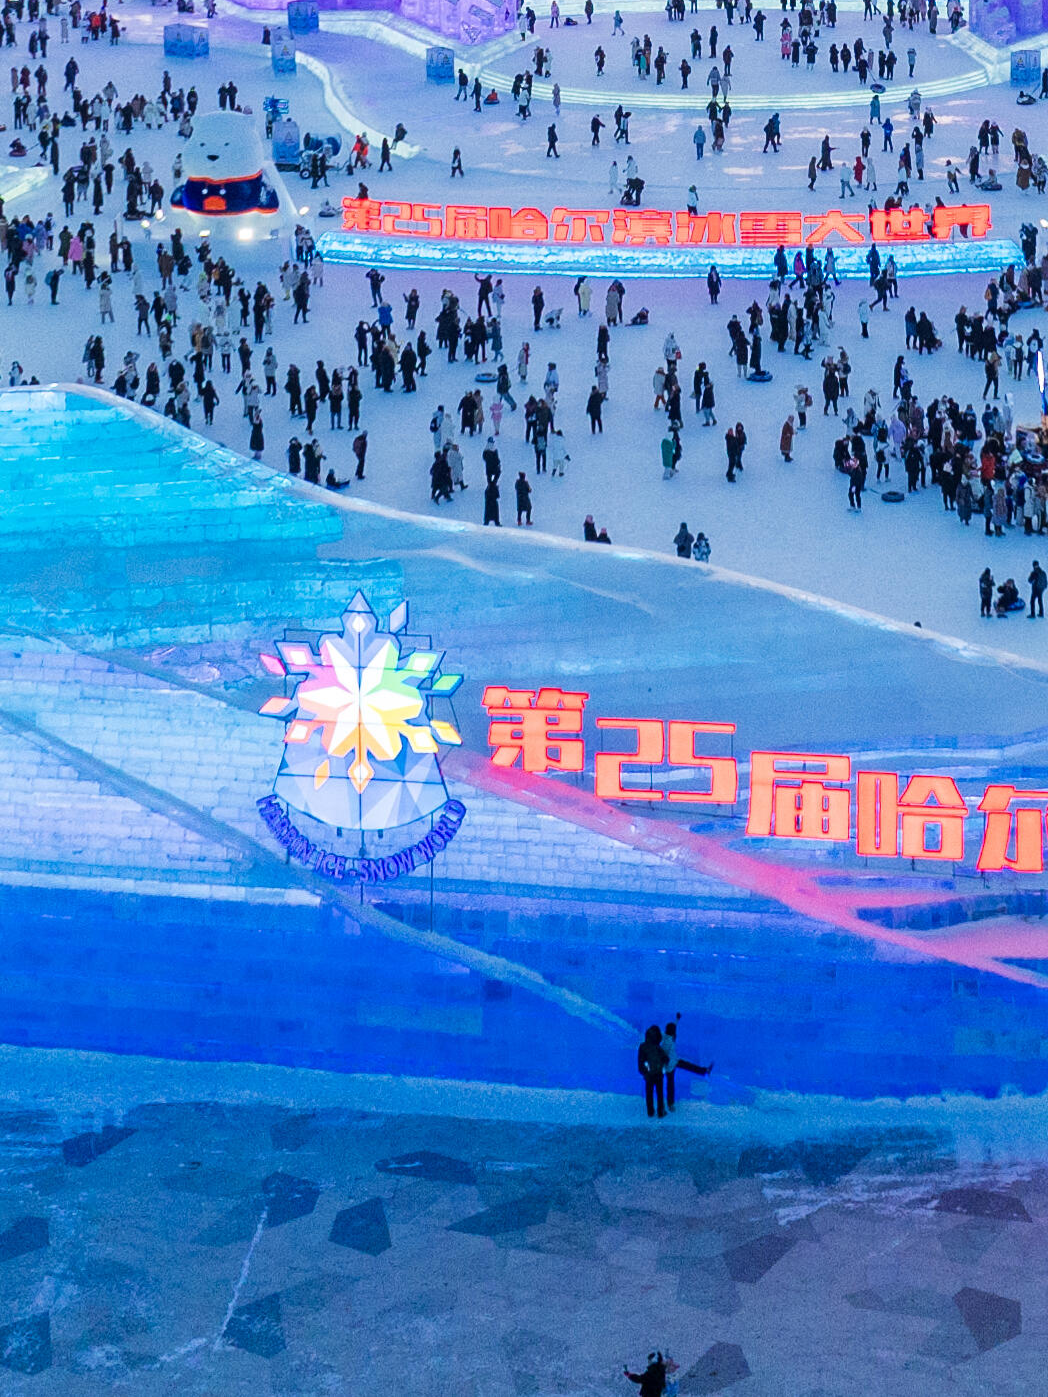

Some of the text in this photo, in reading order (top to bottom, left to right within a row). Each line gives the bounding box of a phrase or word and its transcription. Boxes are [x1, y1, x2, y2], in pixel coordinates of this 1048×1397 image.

[341, 197, 993, 247] 第25届哈尔滨冰雪大世界
[256, 793, 317, 865] HARBIN
[415, 799, 467, 862] WORLD
